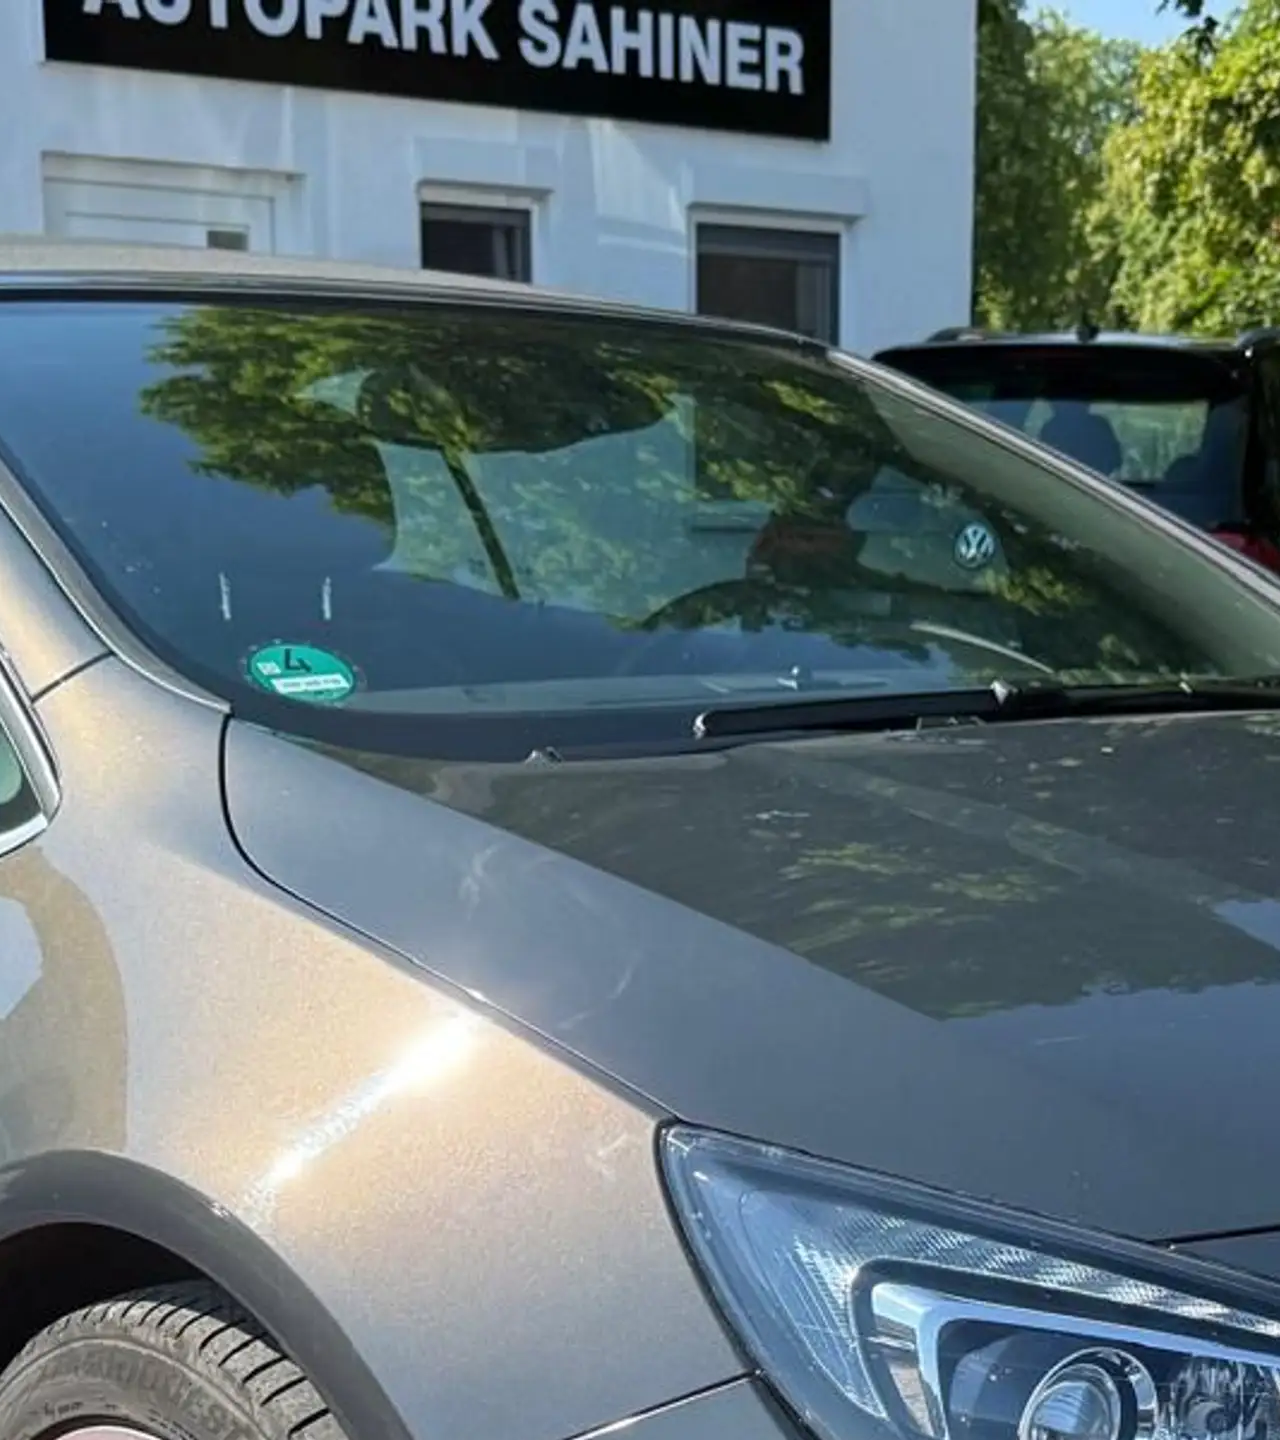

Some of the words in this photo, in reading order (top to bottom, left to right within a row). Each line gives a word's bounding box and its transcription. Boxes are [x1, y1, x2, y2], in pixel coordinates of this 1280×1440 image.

[83, 0, 499, 60] OPARK
[517, 0, 804, 95] SAHINER
[283, 647, 312, 673] 4
